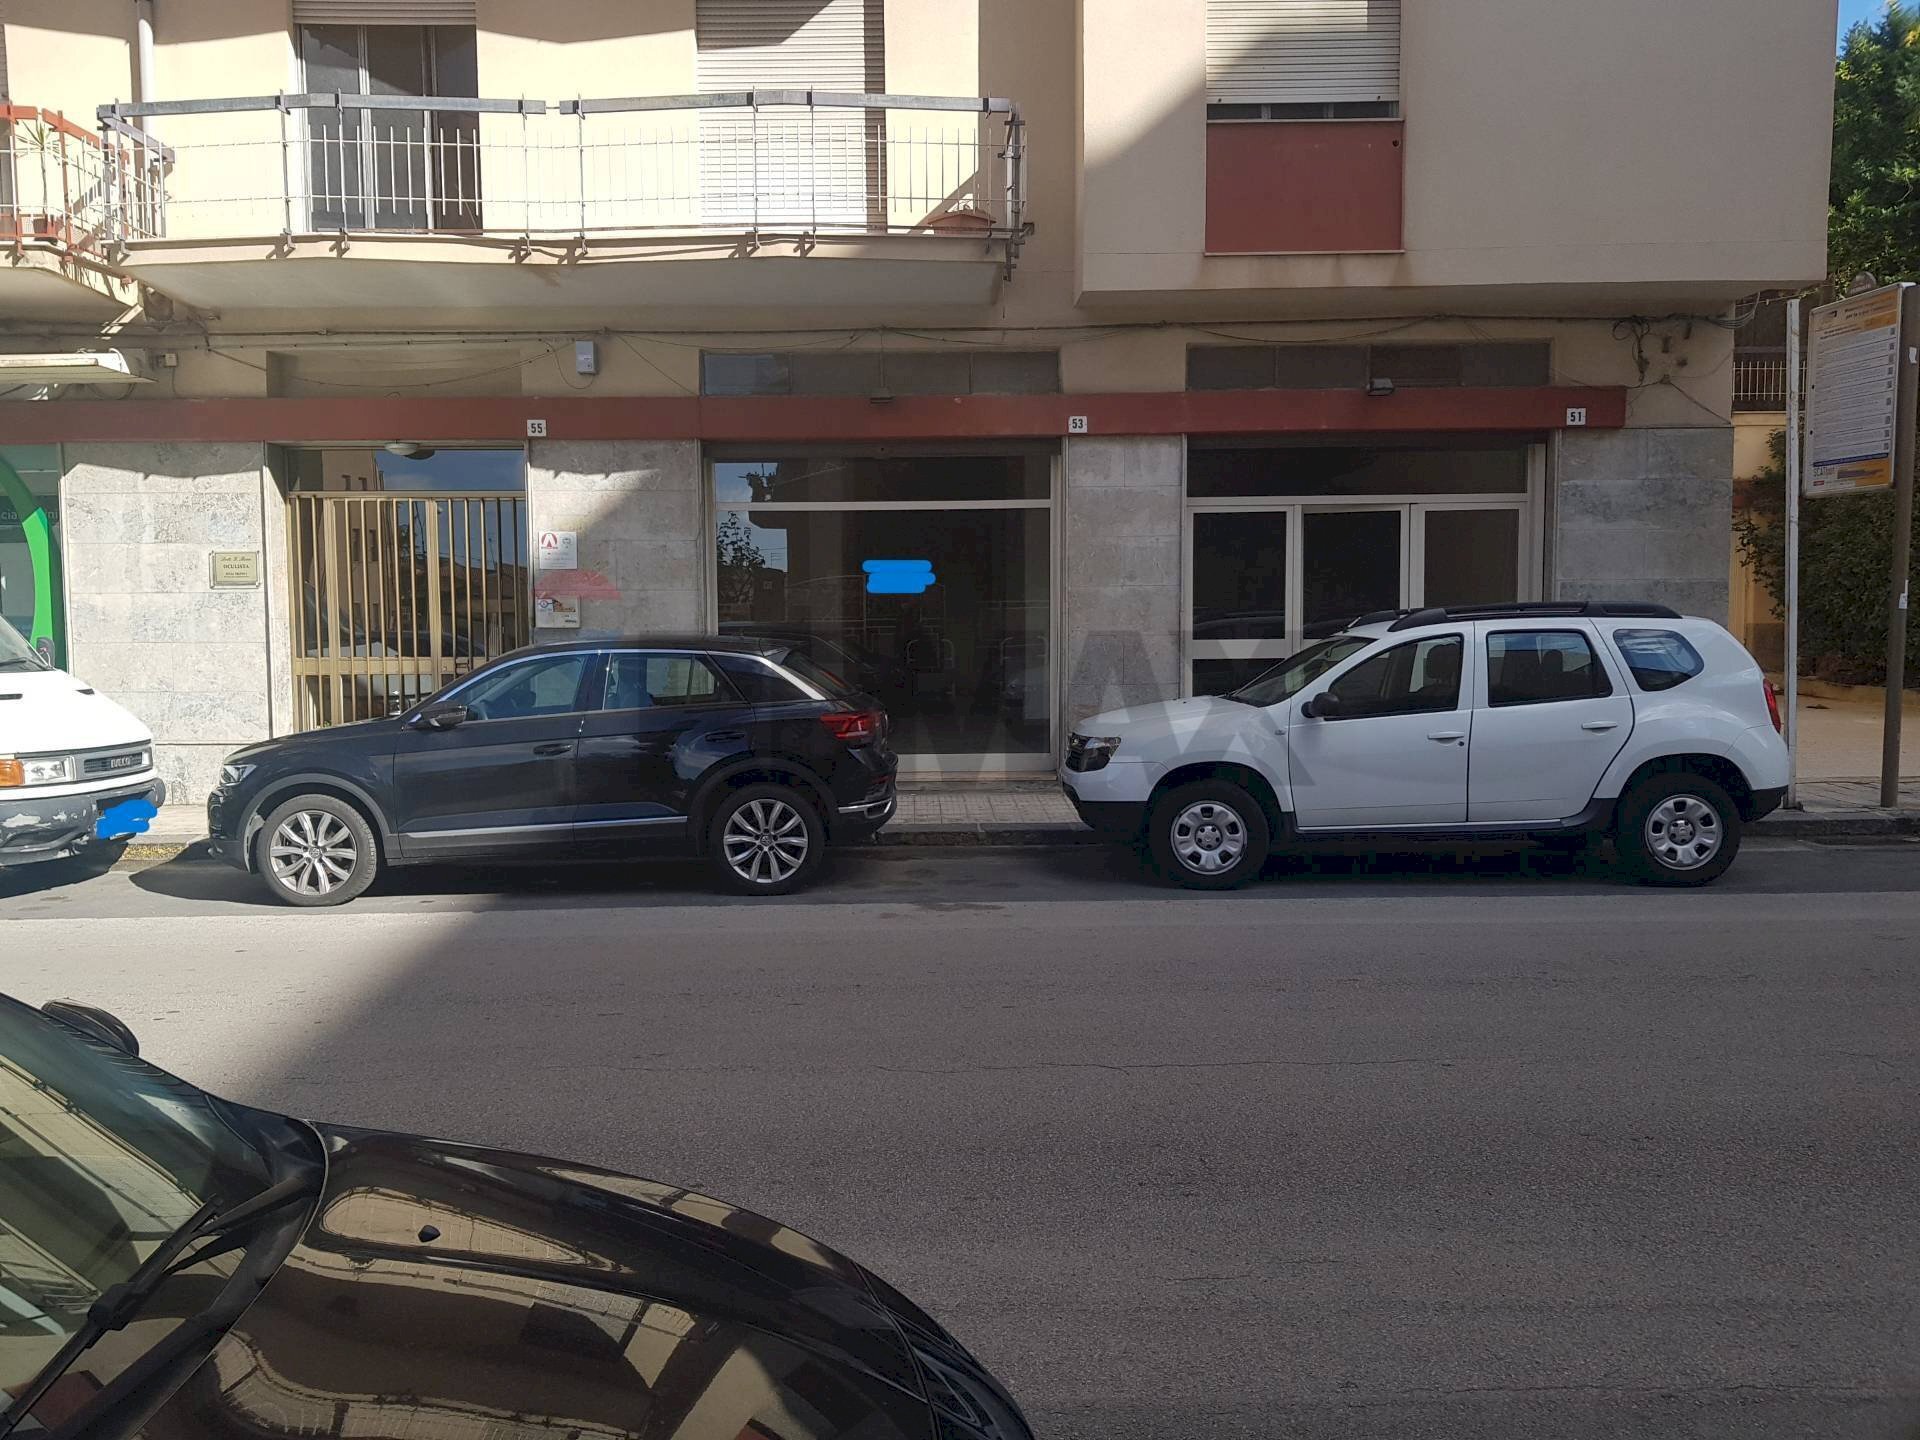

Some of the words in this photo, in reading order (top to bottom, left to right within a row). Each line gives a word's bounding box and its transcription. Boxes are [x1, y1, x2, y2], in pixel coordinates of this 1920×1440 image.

[1570, 411, 1582, 422] 51
[530, 423, 543, 434] 55
[1072, 418, 1083, 429] 53
